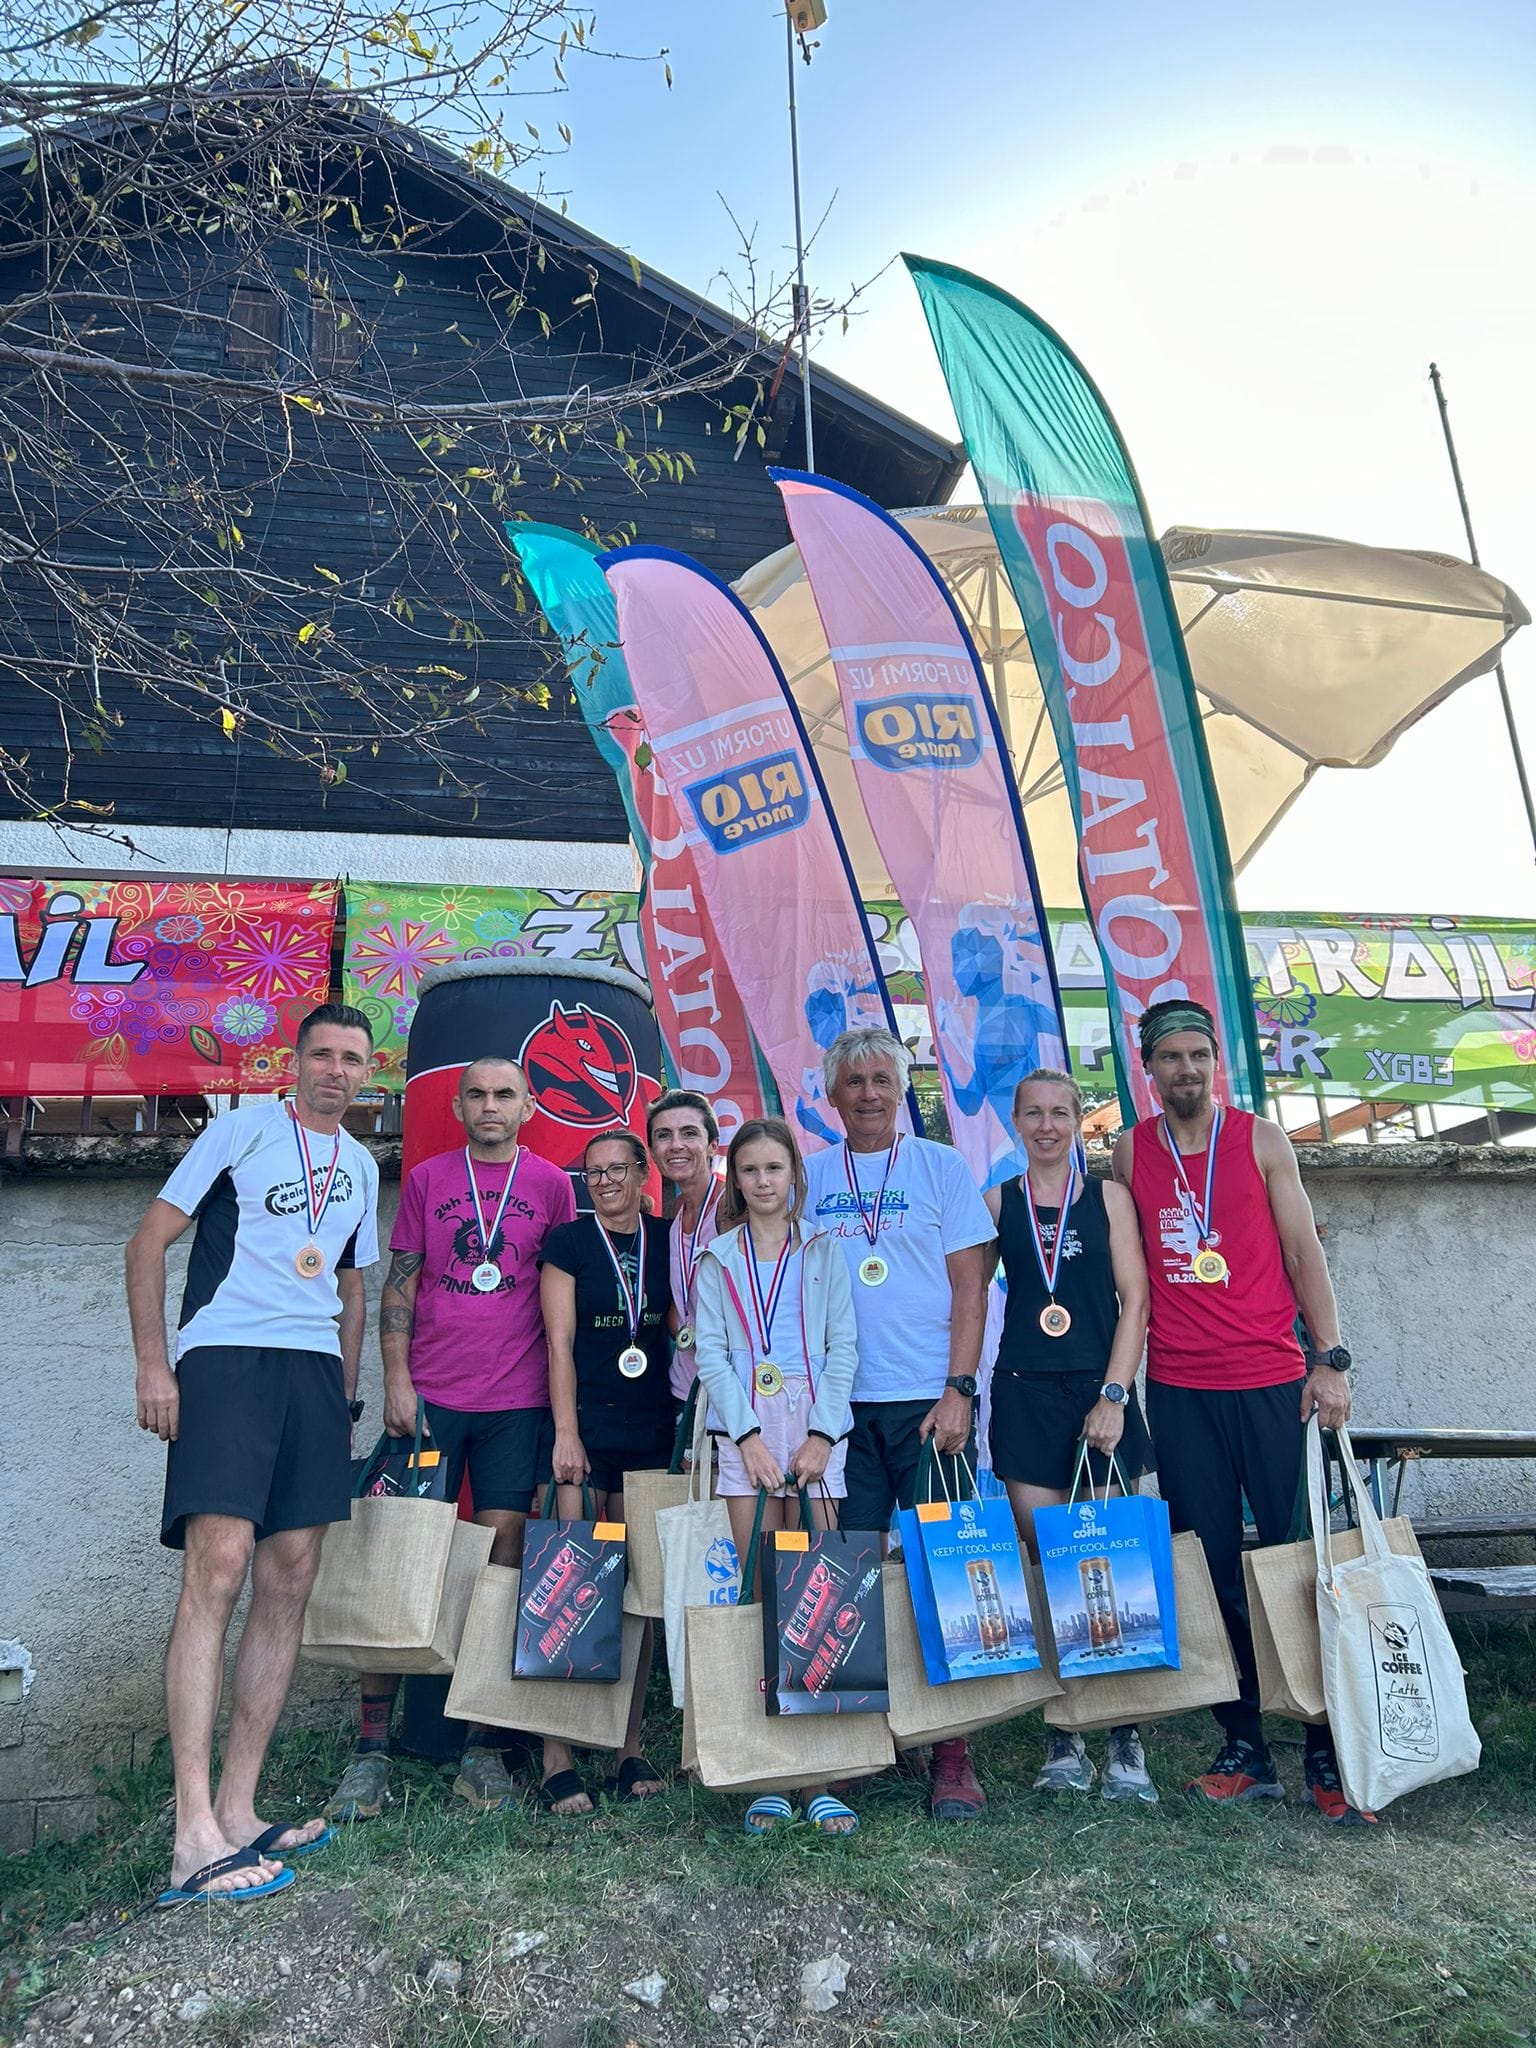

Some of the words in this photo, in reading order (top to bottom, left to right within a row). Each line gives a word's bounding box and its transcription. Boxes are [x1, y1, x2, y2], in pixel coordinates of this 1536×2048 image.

[434, 1197, 461, 1220] 24h
[836, 1197, 905, 1206] DELIN
[440, 1273, 517, 1296] FINISER
[957, 1528, 988, 1540] COFFEE
[964, 1522, 977, 1530] ICE
[1073, 1527, 1108, 1539] COFFEE
[1082, 1522, 1096, 1530] ICE
[933, 1546, 956, 1557] KEEP
[956, 1545, 963, 1555] IT
[965, 1543, 990, 1554] COOL
[991, 1542, 1002, 1552] AS
[1002, 1542, 1014, 1552] ICE
[1046, 1547, 1069, 1559] KEEP
[1070, 1545, 1078, 1555] IT
[1079, 1542, 1108, 1553] COOL
[1110, 1540, 1123, 1550] AS
[1124, 1537, 1141, 1548] ICE
[529, 1563, 567, 1610] HELL
[709, 1585, 738, 1606] ICE
[789, 1585, 824, 1635] HELL
[538, 1605, 579, 1660] HELL
[802, 1632, 842, 1694] HELL
[1392, 1652, 1409, 1662] ICE
[1381, 1661, 1423, 1675] COFFEE
[1390, 1679, 1420, 1696] Latte
